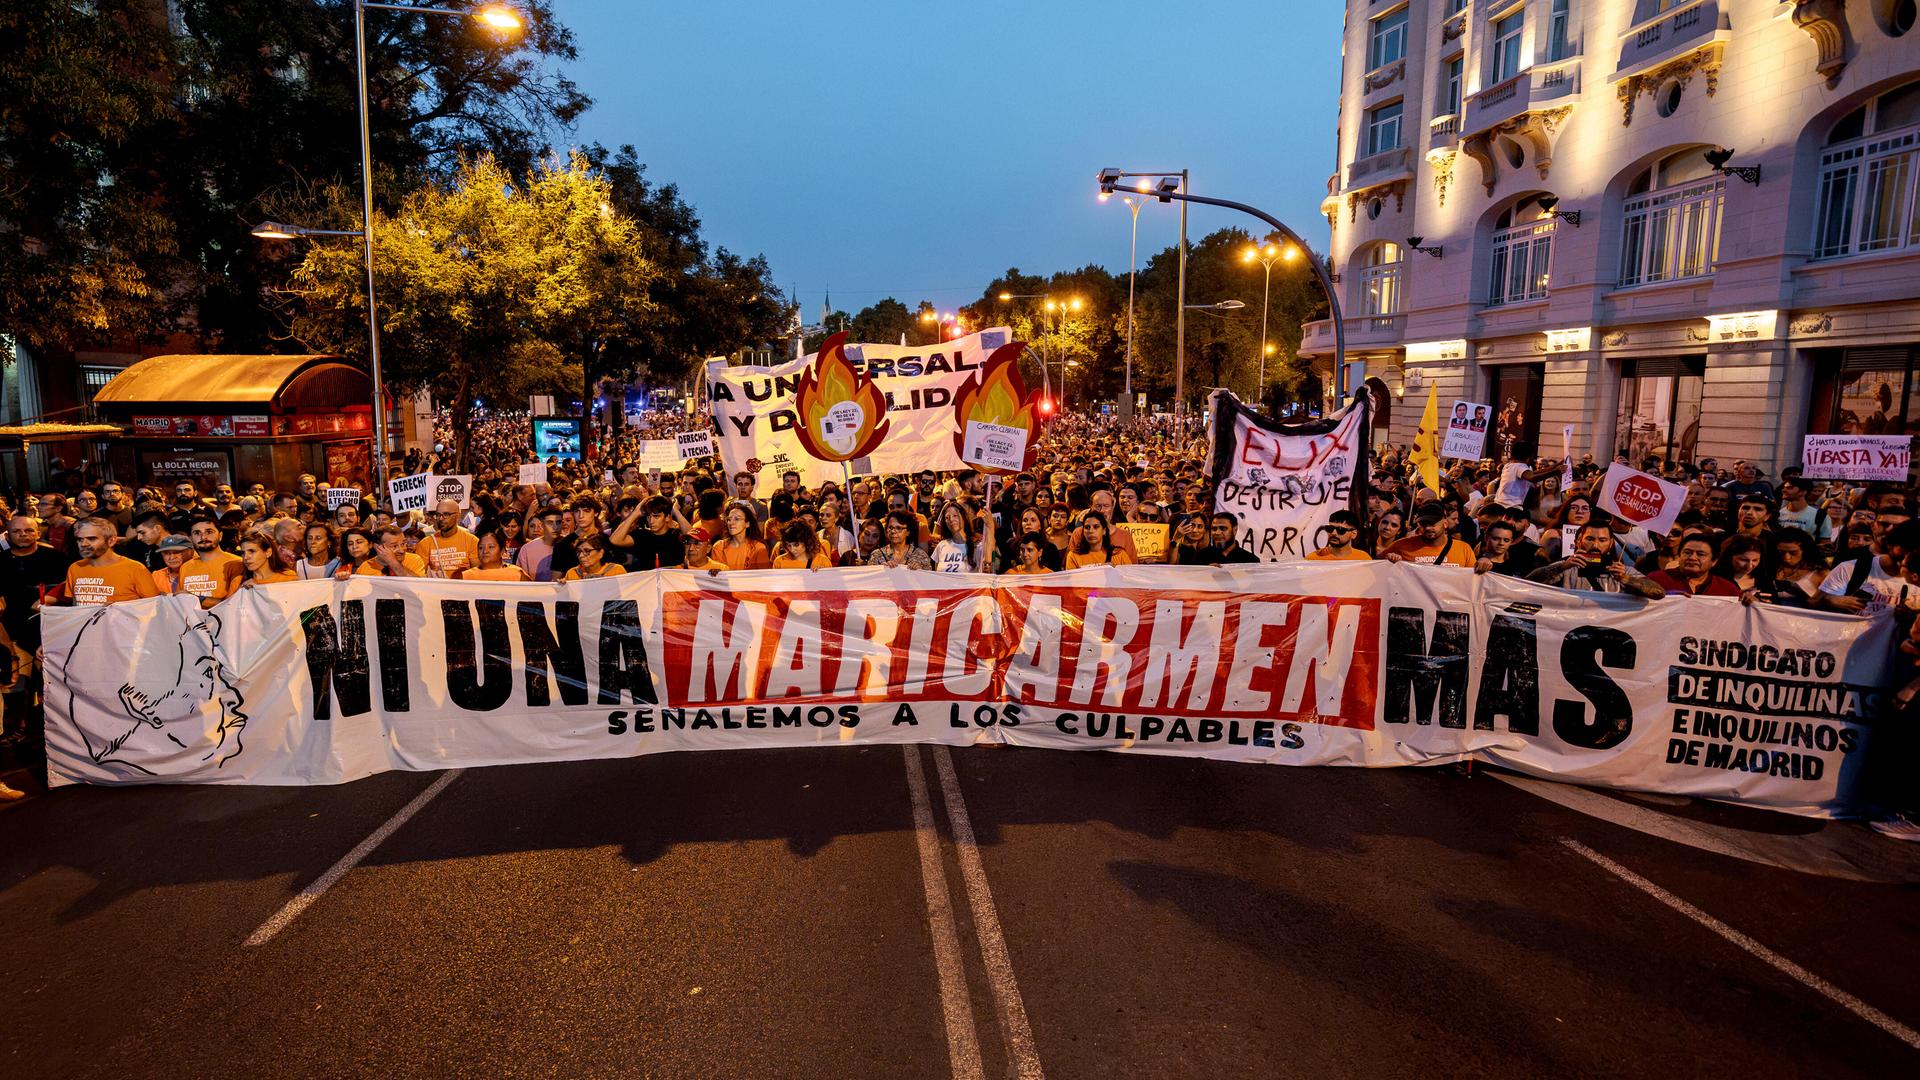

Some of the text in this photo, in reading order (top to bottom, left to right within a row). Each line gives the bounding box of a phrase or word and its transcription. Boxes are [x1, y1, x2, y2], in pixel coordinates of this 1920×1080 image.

[135, 418, 170, 427] MADRID
[977, 423, 998, 432] CAMPOS
[678, 433, 707, 445] DERECHO
[682, 448, 688, 458] A
[688, 446, 711, 457] TECHO.
[773, 453, 788, 462] SVC
[328, 490, 359, 498] DERECHO
[438, 484, 462, 493] STOP
[1621, 481, 1662, 503] STOP
[398, 499, 404, 511] A
[1615, 492, 1659, 517] DESAHUCIOS
[945, 564, 959, 573] 22
[185, 574, 209, 583] SINDICATO
[80, 586, 113, 594] INQUILINAS
[1678, 635, 1836, 679] SINDICATO
[300, 594, 1638, 750] NI UNA MARICARMEN MÁS
[1677, 673, 1881, 717] DE INQUILINAS
[892, 703, 918, 726] A
[950, 703, 1022, 728] LOS
[1056, 712, 1305, 749] CULPABLES
[1671, 708, 1860, 754] E INQUILINOS
[1665, 738, 1825, 782] DE MADRID
